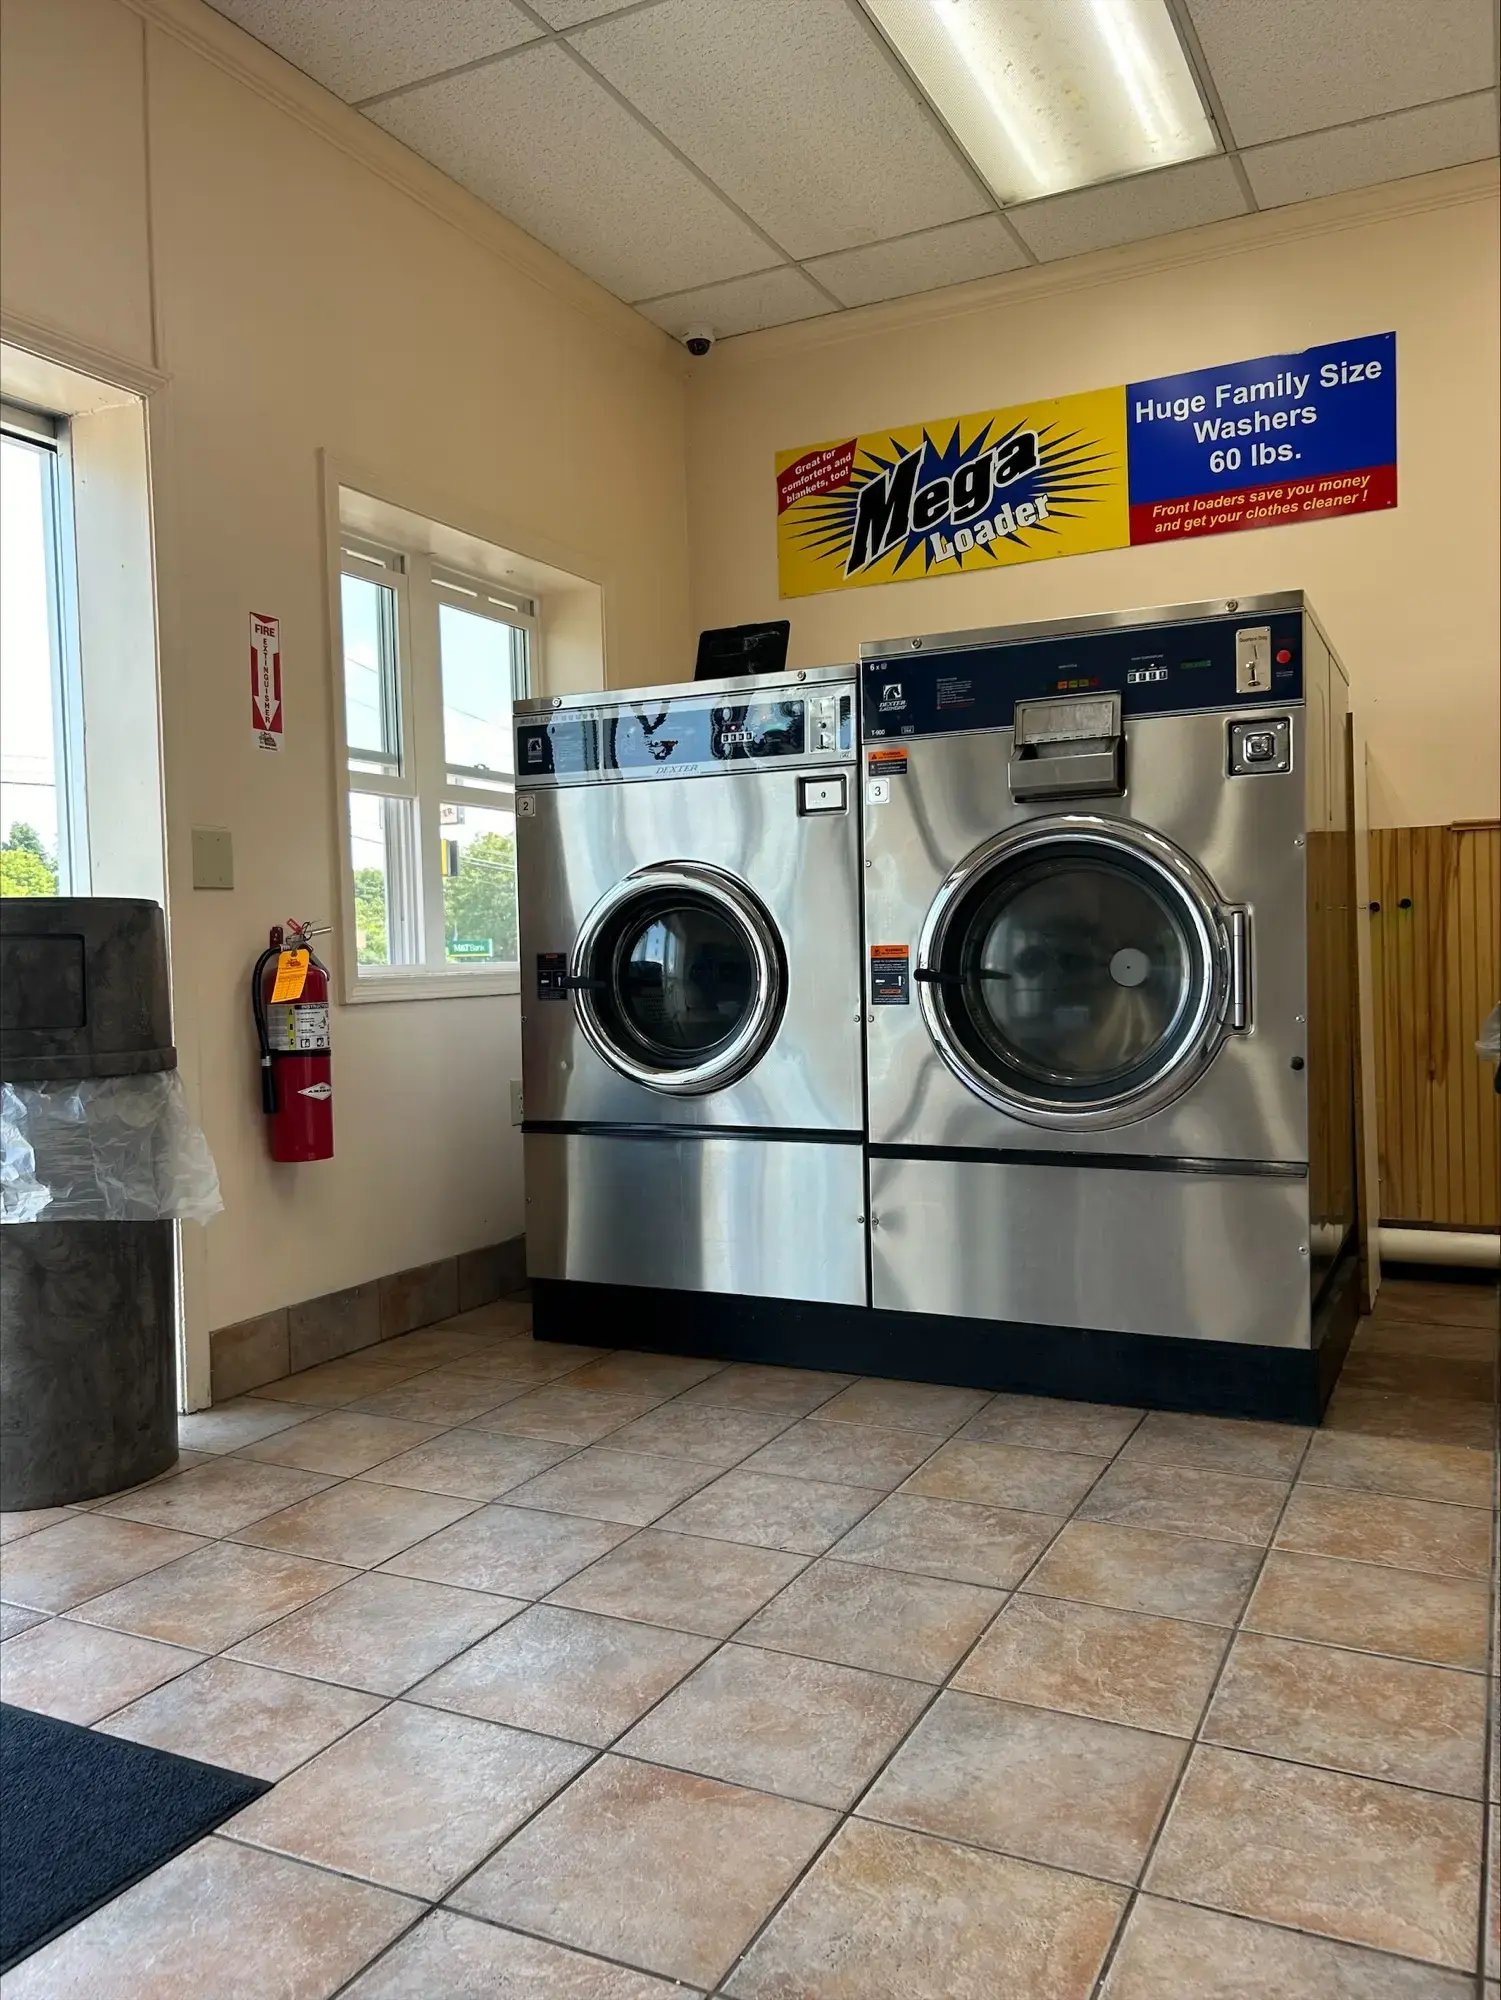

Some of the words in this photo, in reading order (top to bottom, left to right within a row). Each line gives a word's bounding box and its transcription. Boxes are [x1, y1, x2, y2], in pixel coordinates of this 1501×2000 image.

[1135, 393, 1206, 423] Huge
[1215, 371, 1310, 409] Family
[1319, 360, 1383, 388] Size
[1193, 406, 1318, 444] Washers
[781, 464, 832, 494] comforters
[834, 452, 852, 468] and
[794, 456, 821, 475] Great
[822, 449, 836, 462] for
[1208, 448, 1242, 474] 60
[1251, 442, 1302, 467] lbs.
[786, 479, 829, 504] blankets,
[830, 465, 849, 482] too!
[1152, 502, 1189, 518] Front
[1193, 496, 1245, 512] loaders
[1249, 488, 1283, 503] save
[1287, 483, 1315, 499] you
[1318, 474, 1371, 493] money
[842, 429, 1041, 581] Mega
[1154, 518, 1181, 533] and
[1184, 514, 1207, 532] get
[1210, 510, 1242, 528] your
[1245, 503, 1299, 520] clothes
[1302, 494, 1359, 512] cleaner
[929, 493, 1051, 565] Loader
[254, 623, 276, 638] FIRE
[262, 638, 271, 724] EXTINGUISHER
[655, 764, 698, 775] DEXTER
[523, 801, 529, 811] 2
[874, 786, 881, 797] 3
